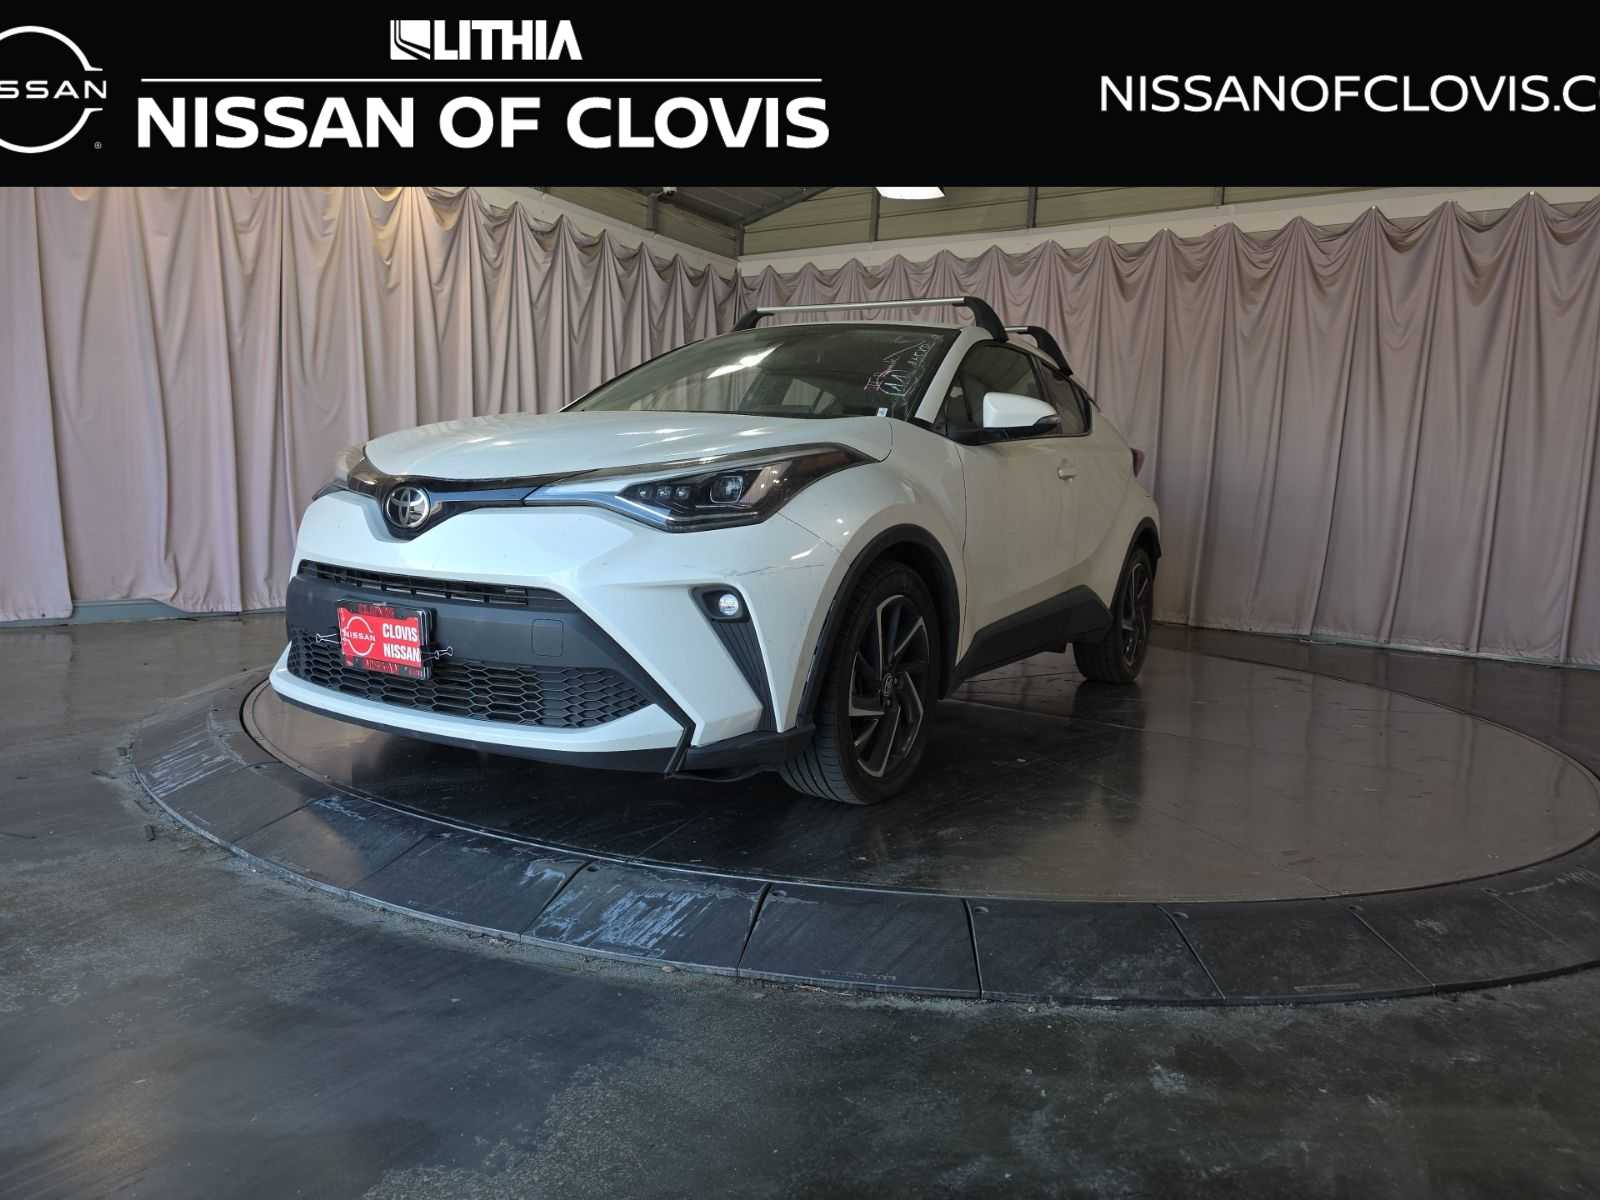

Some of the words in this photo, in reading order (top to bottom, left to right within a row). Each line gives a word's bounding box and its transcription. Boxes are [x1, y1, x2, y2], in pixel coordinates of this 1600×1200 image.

[343, 630, 375, 641] NISSAN
[383, 623, 418, 642] CLOVIS
[384, 643, 421, 662] NISSAN
